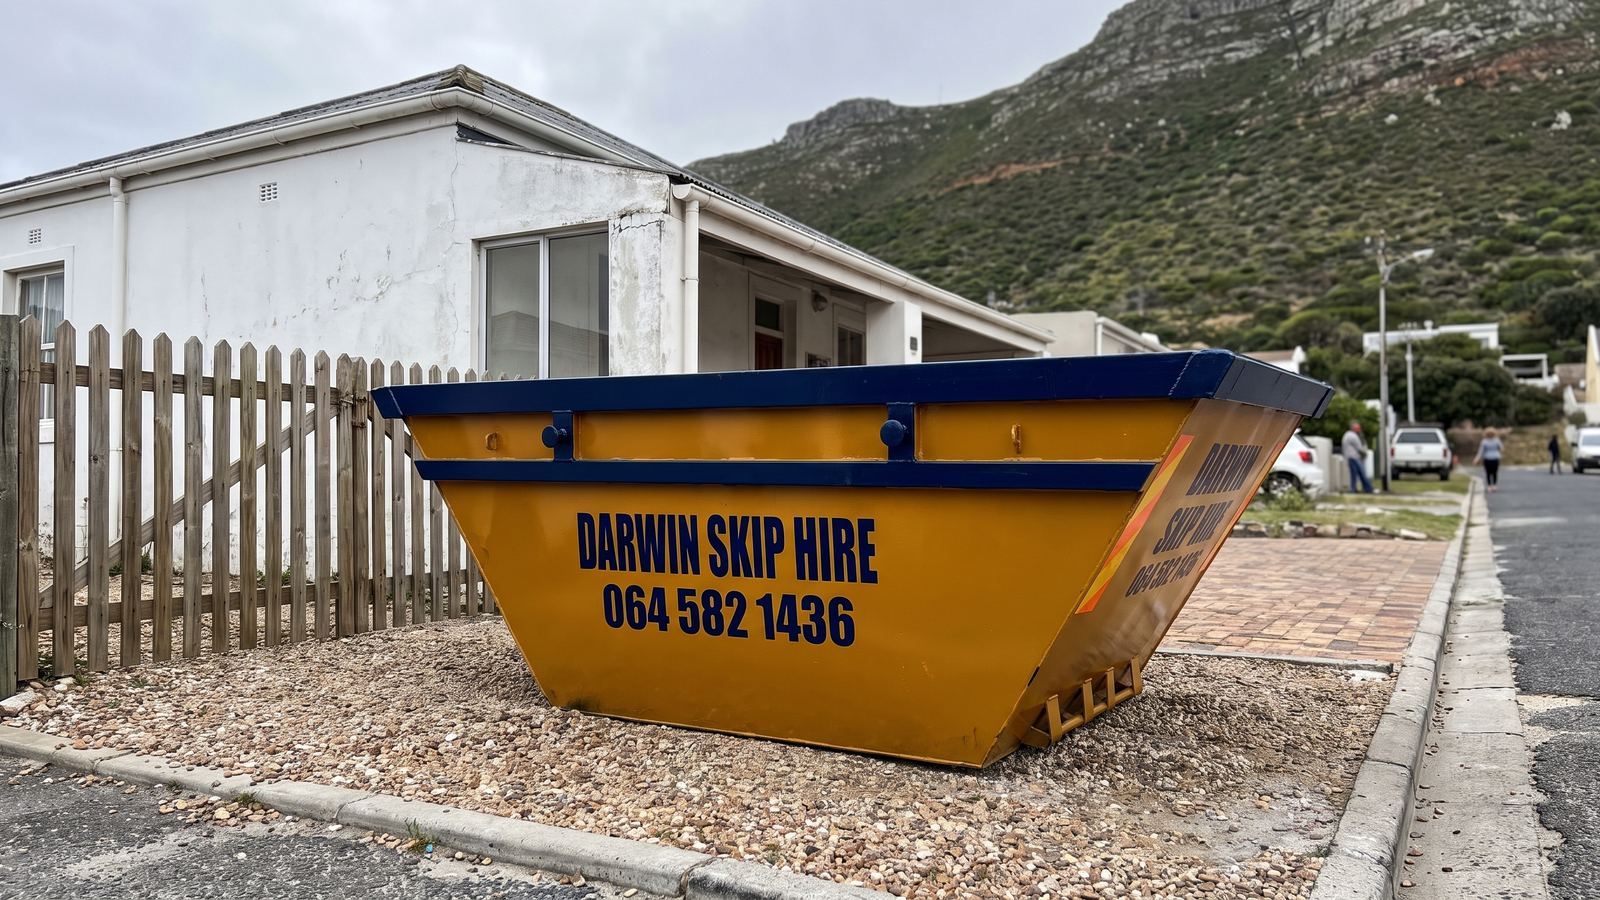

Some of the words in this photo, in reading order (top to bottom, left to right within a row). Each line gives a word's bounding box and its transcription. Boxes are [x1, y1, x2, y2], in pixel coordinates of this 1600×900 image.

[577, 512, 701, 575] DARWIN
[707, 514, 785, 579] SKIP
[793, 516, 878, 584] HIRE
[1153, 505, 1206, 555] SKIP
[603, 583, 670, 632] 064
[677, 587, 749, 638] 582
[756, 592, 855, 647] 1436
